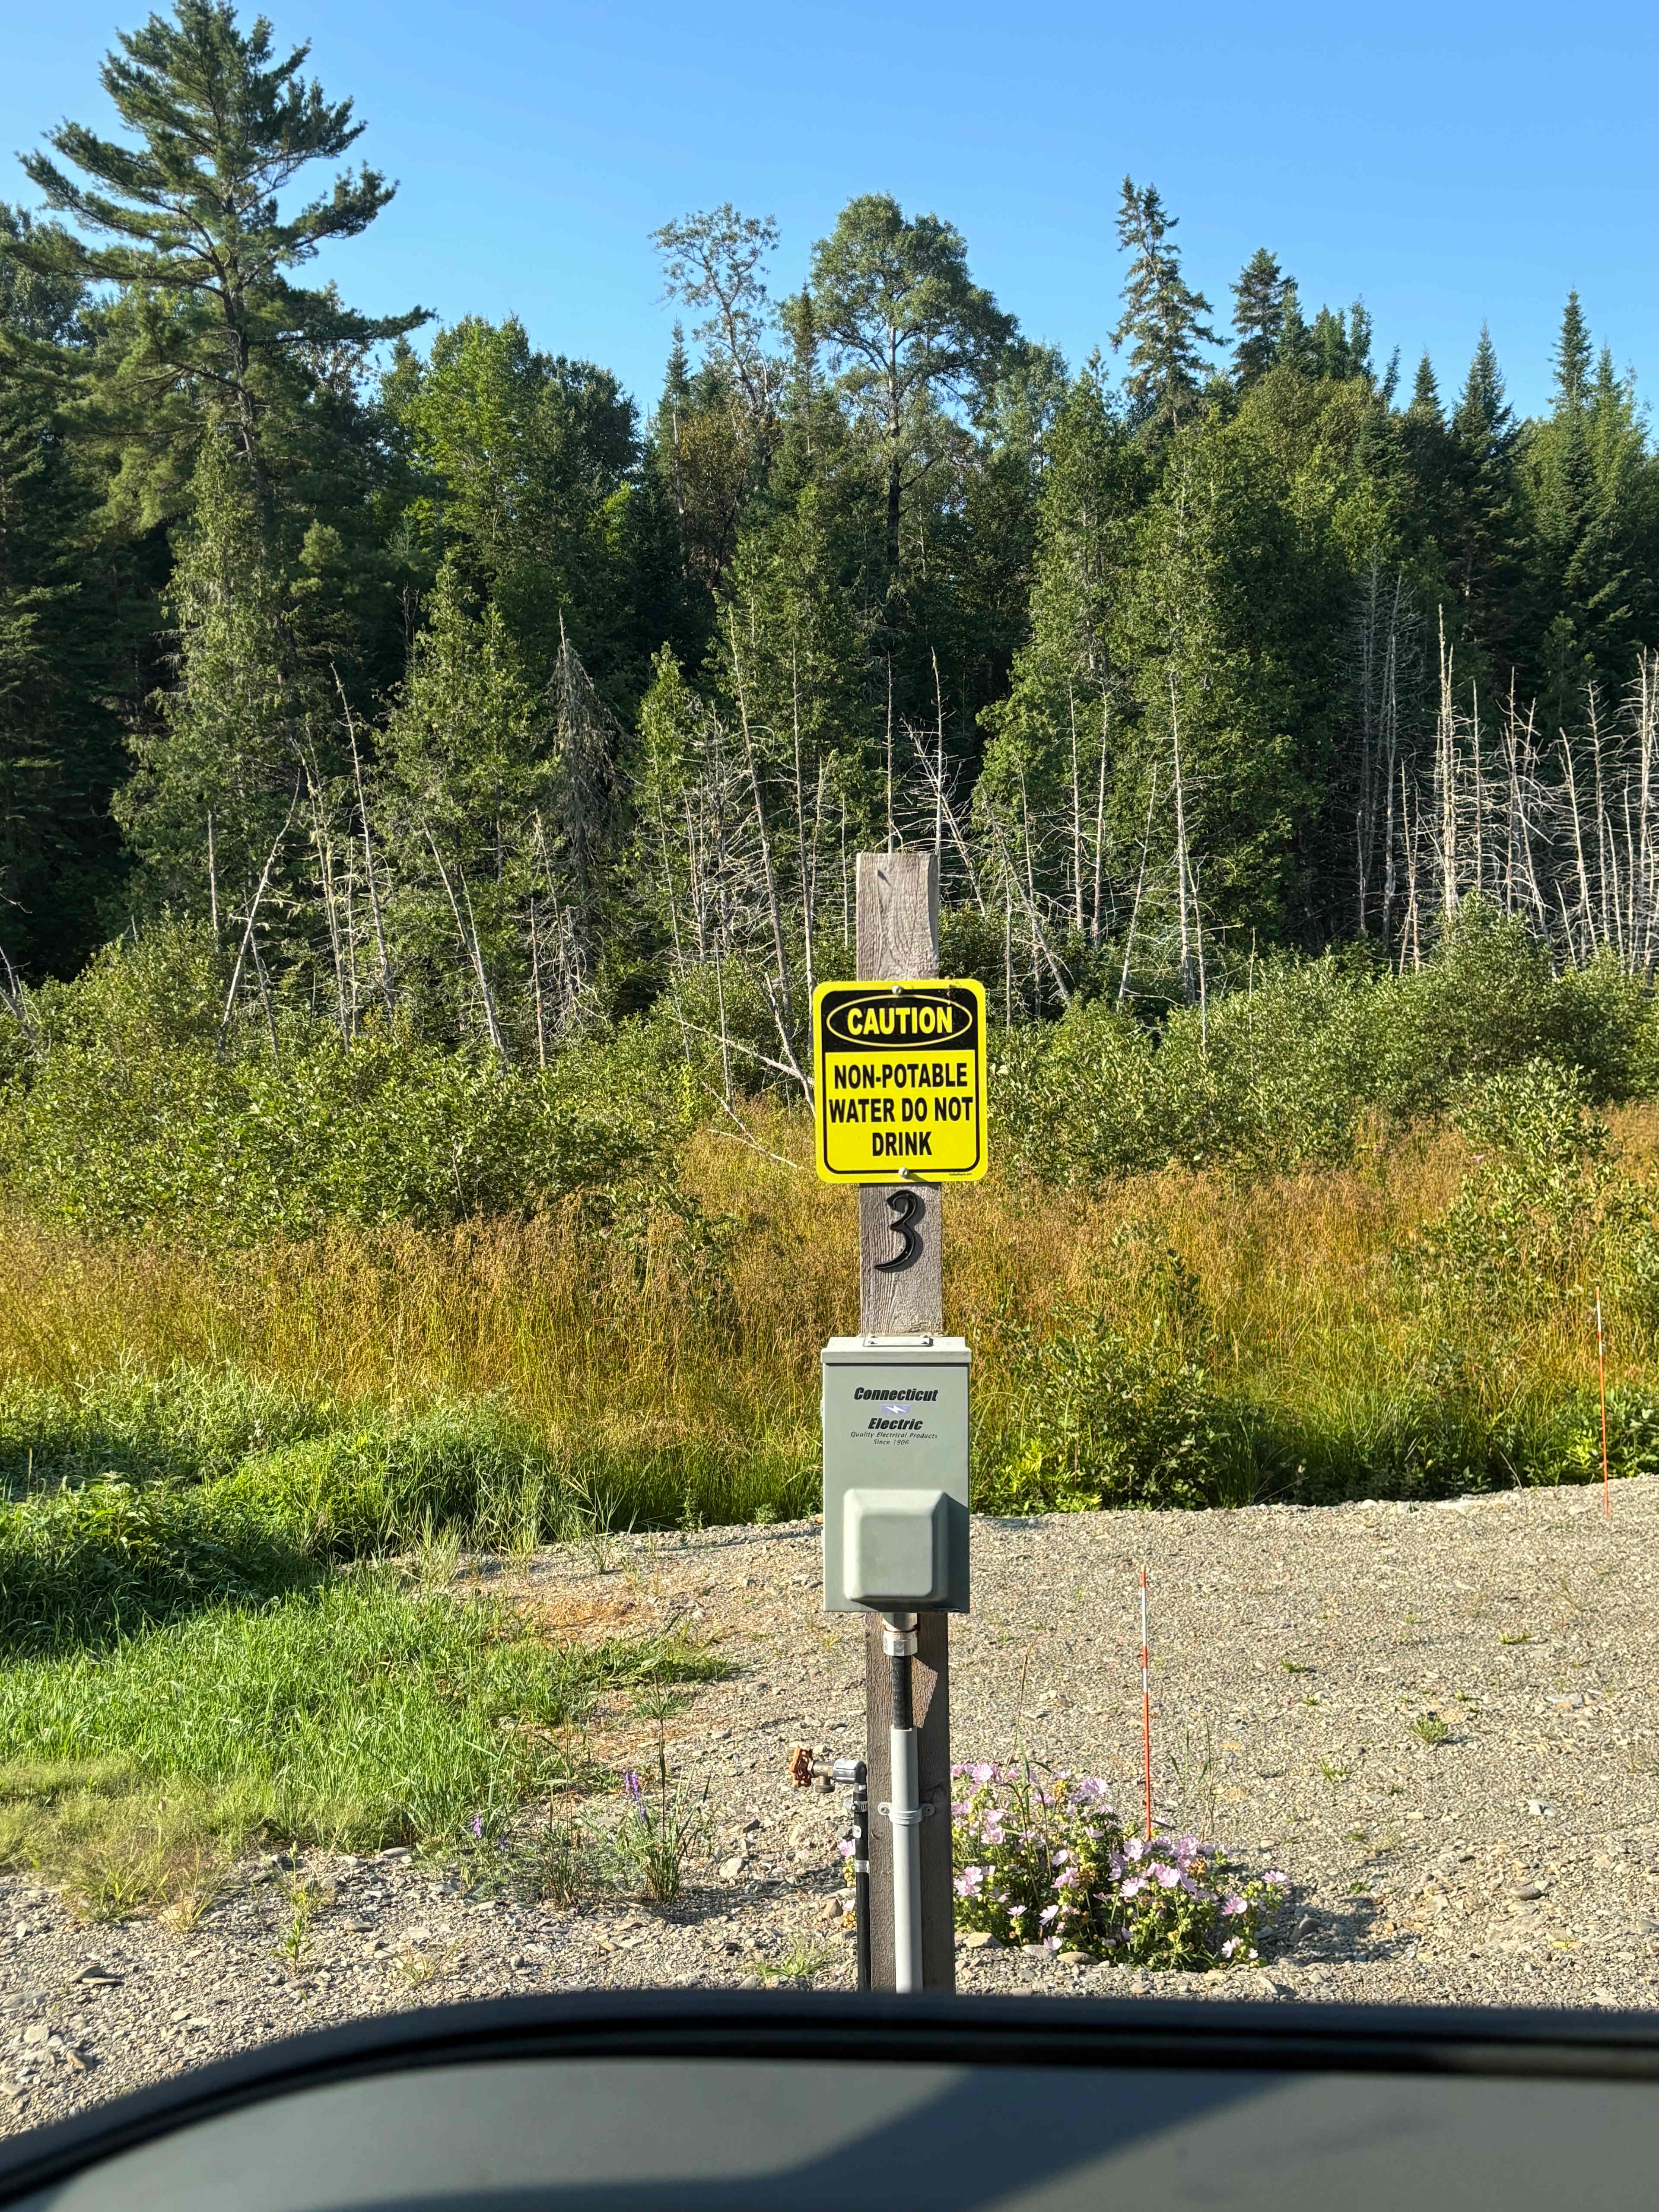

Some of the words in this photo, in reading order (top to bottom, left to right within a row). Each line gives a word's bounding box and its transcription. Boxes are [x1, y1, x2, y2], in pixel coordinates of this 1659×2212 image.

[847, 1006, 953, 1035] CAUTION
[834, 1063, 968, 1089] NON-POTABLE
[829, 1098, 895, 1123] WATER
[902, 1097, 928, 1122] DO
[934, 1096, 973, 1121] NOT
[872, 1131, 932, 1157] DRINK
[874, 1190, 918, 1269] 3
[854, 1387, 938, 1401] Connecticut
[868, 1417, 923, 1430] Electric
